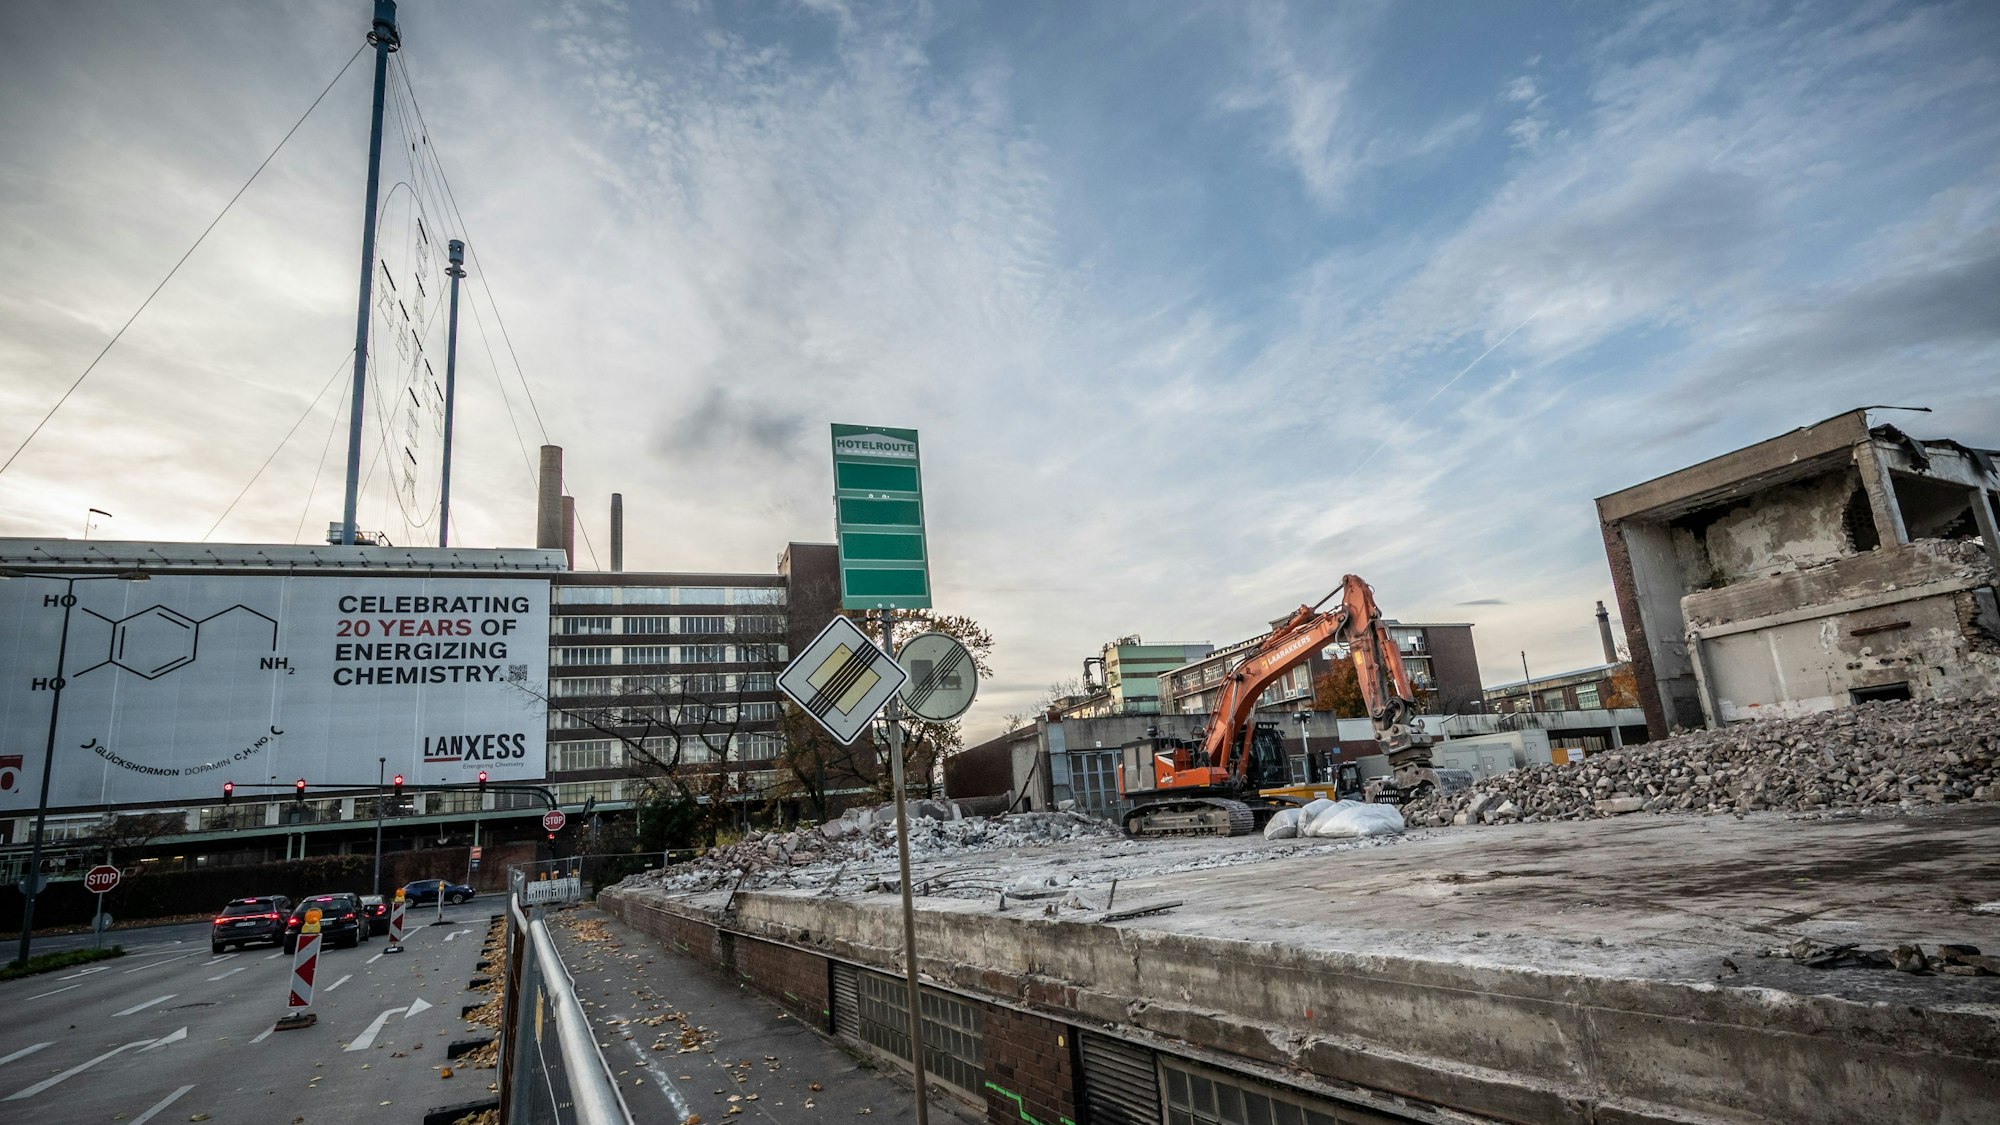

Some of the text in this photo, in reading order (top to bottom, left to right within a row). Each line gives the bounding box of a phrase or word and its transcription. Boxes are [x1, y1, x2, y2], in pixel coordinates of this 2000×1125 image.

[837, 439, 915, 453] HOTELROUTE
[43, 594, 78, 608] HO
[338, 595, 529, 614] CELEBRATING
[336, 618, 517, 637] 20 YEARS OF
[335, 642, 507, 661] ENERGIZING
[1267, 635, 1311, 665] LAARAKKERS
[31, 677, 66, 691] HO
[333, 665, 504, 686] CHEMISTRY.
[424, 733, 526, 761] LANXESS
[95, 746, 180, 776] GLÜCKSHORMON
[184, 758, 231, 776] DOPAMIN
[545, 816, 563, 826] STOP
[88, 872, 117, 885] STOP
